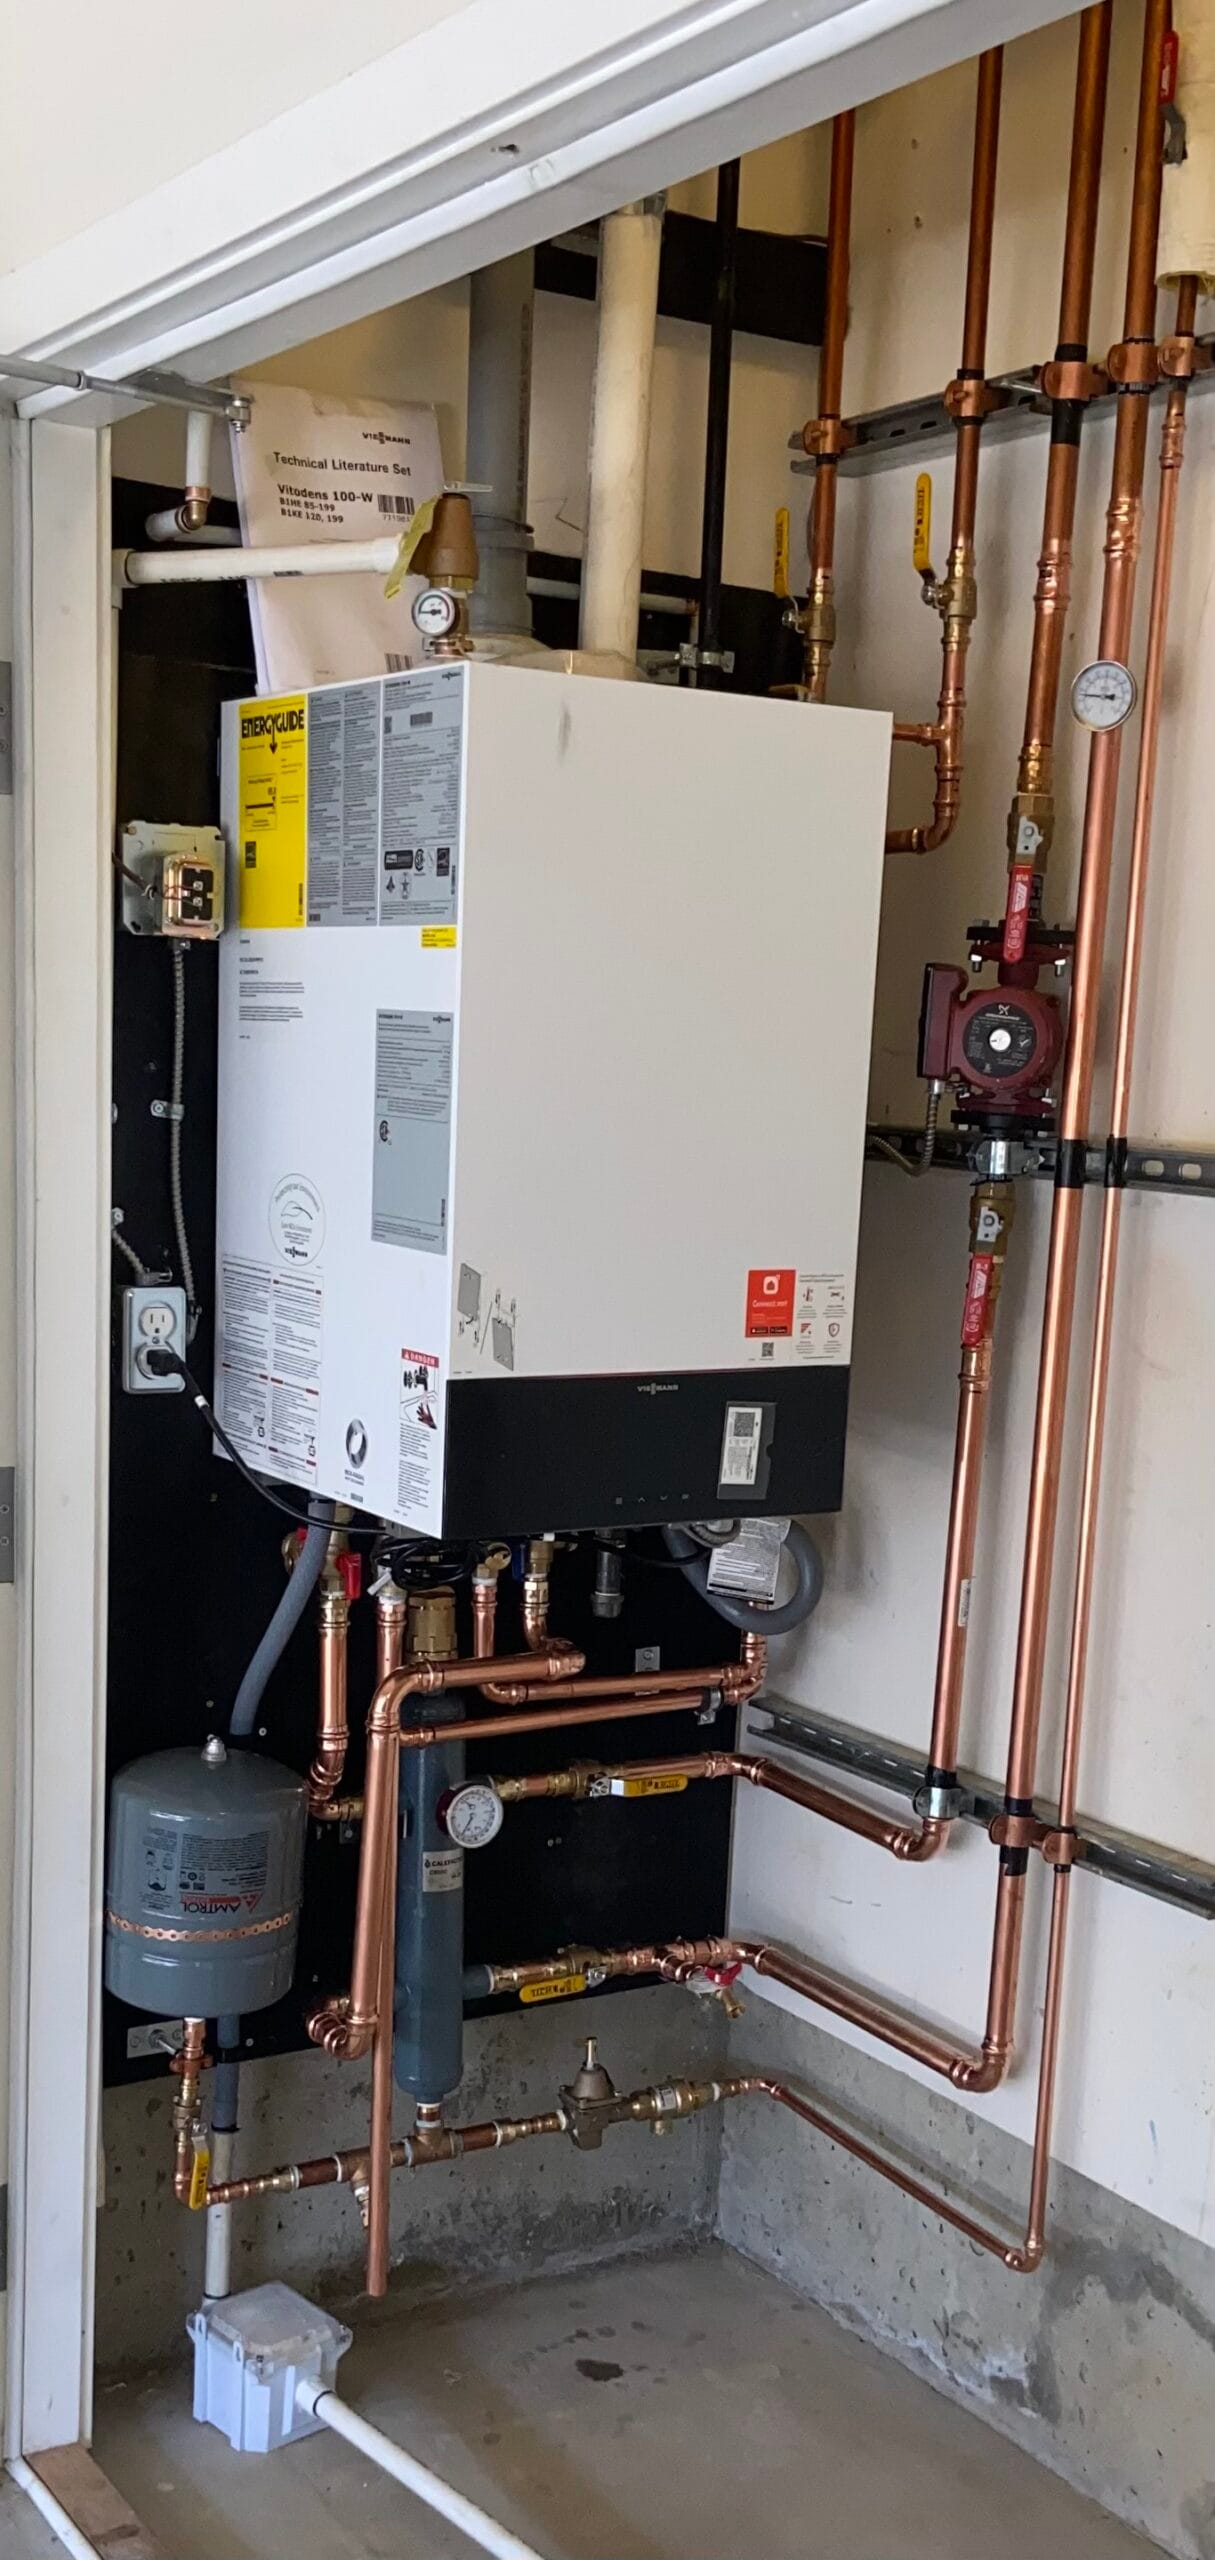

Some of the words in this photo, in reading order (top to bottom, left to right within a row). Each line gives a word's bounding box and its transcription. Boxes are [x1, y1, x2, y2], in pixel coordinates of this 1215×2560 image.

[273, 452, 328, 470] Technical
[332, 459, 389, 473] Literature
[392, 463, 411, 476] Set
[277, 483, 329, 500] Vitodens
[333, 491, 373, 503] 100-W
[304, 501, 336, 512] 85-199
[327, 514, 344, 523] 199
[241, 709, 305, 739] ENERGYGUIDE
[181, 1901, 241, 1914] AMTROL
